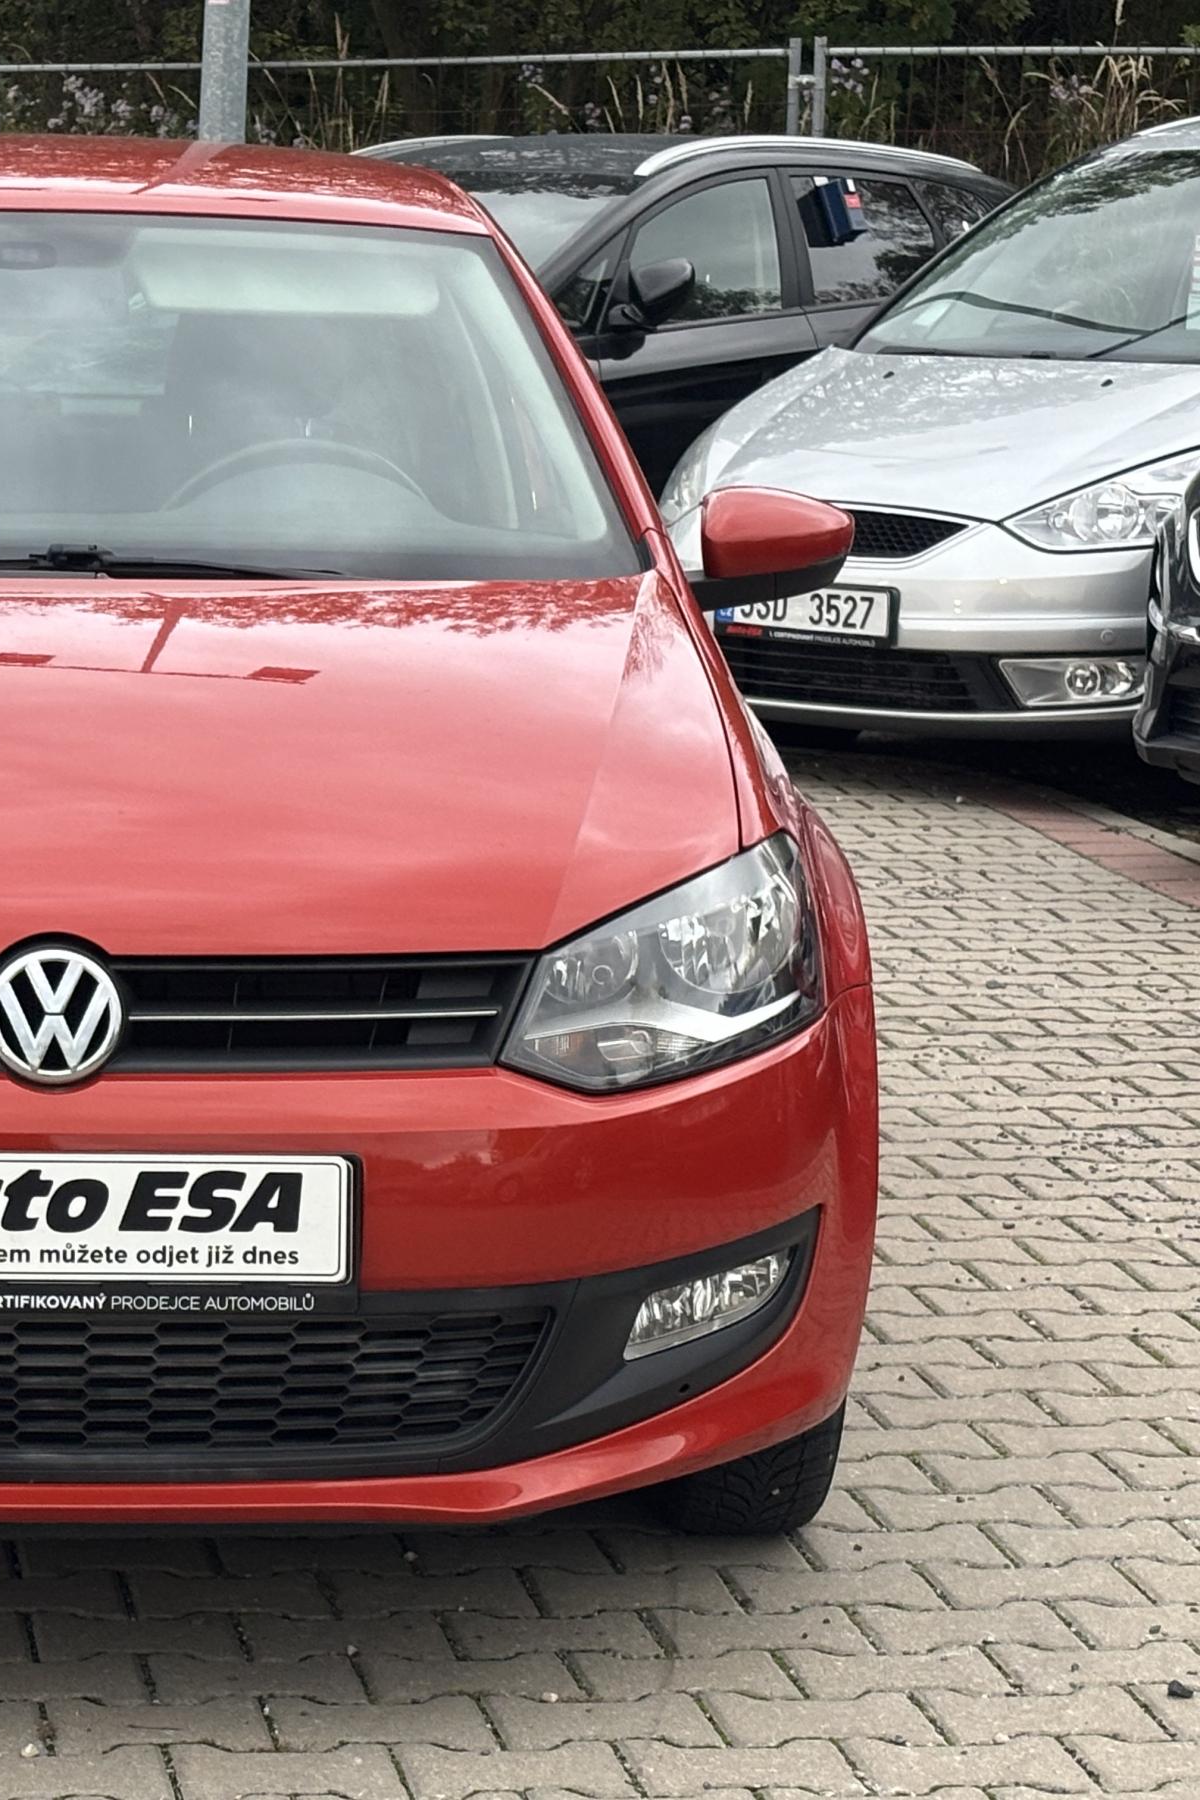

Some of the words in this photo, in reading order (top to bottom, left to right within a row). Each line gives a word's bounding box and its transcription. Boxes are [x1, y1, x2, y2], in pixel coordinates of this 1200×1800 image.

[809, 593, 875, 630] 3527
[118, 1170, 303, 1234] ESA
[39, 1242, 128, 1264] můžete
[136, 1245, 199, 1267] odjet
[206, 1245, 234, 1267] již
[242, 1246, 299, 1264] dnes
[111, 1295, 200, 1311] PRODEJCE
[204, 1292, 315, 1311] AUTOMOBILŮ
